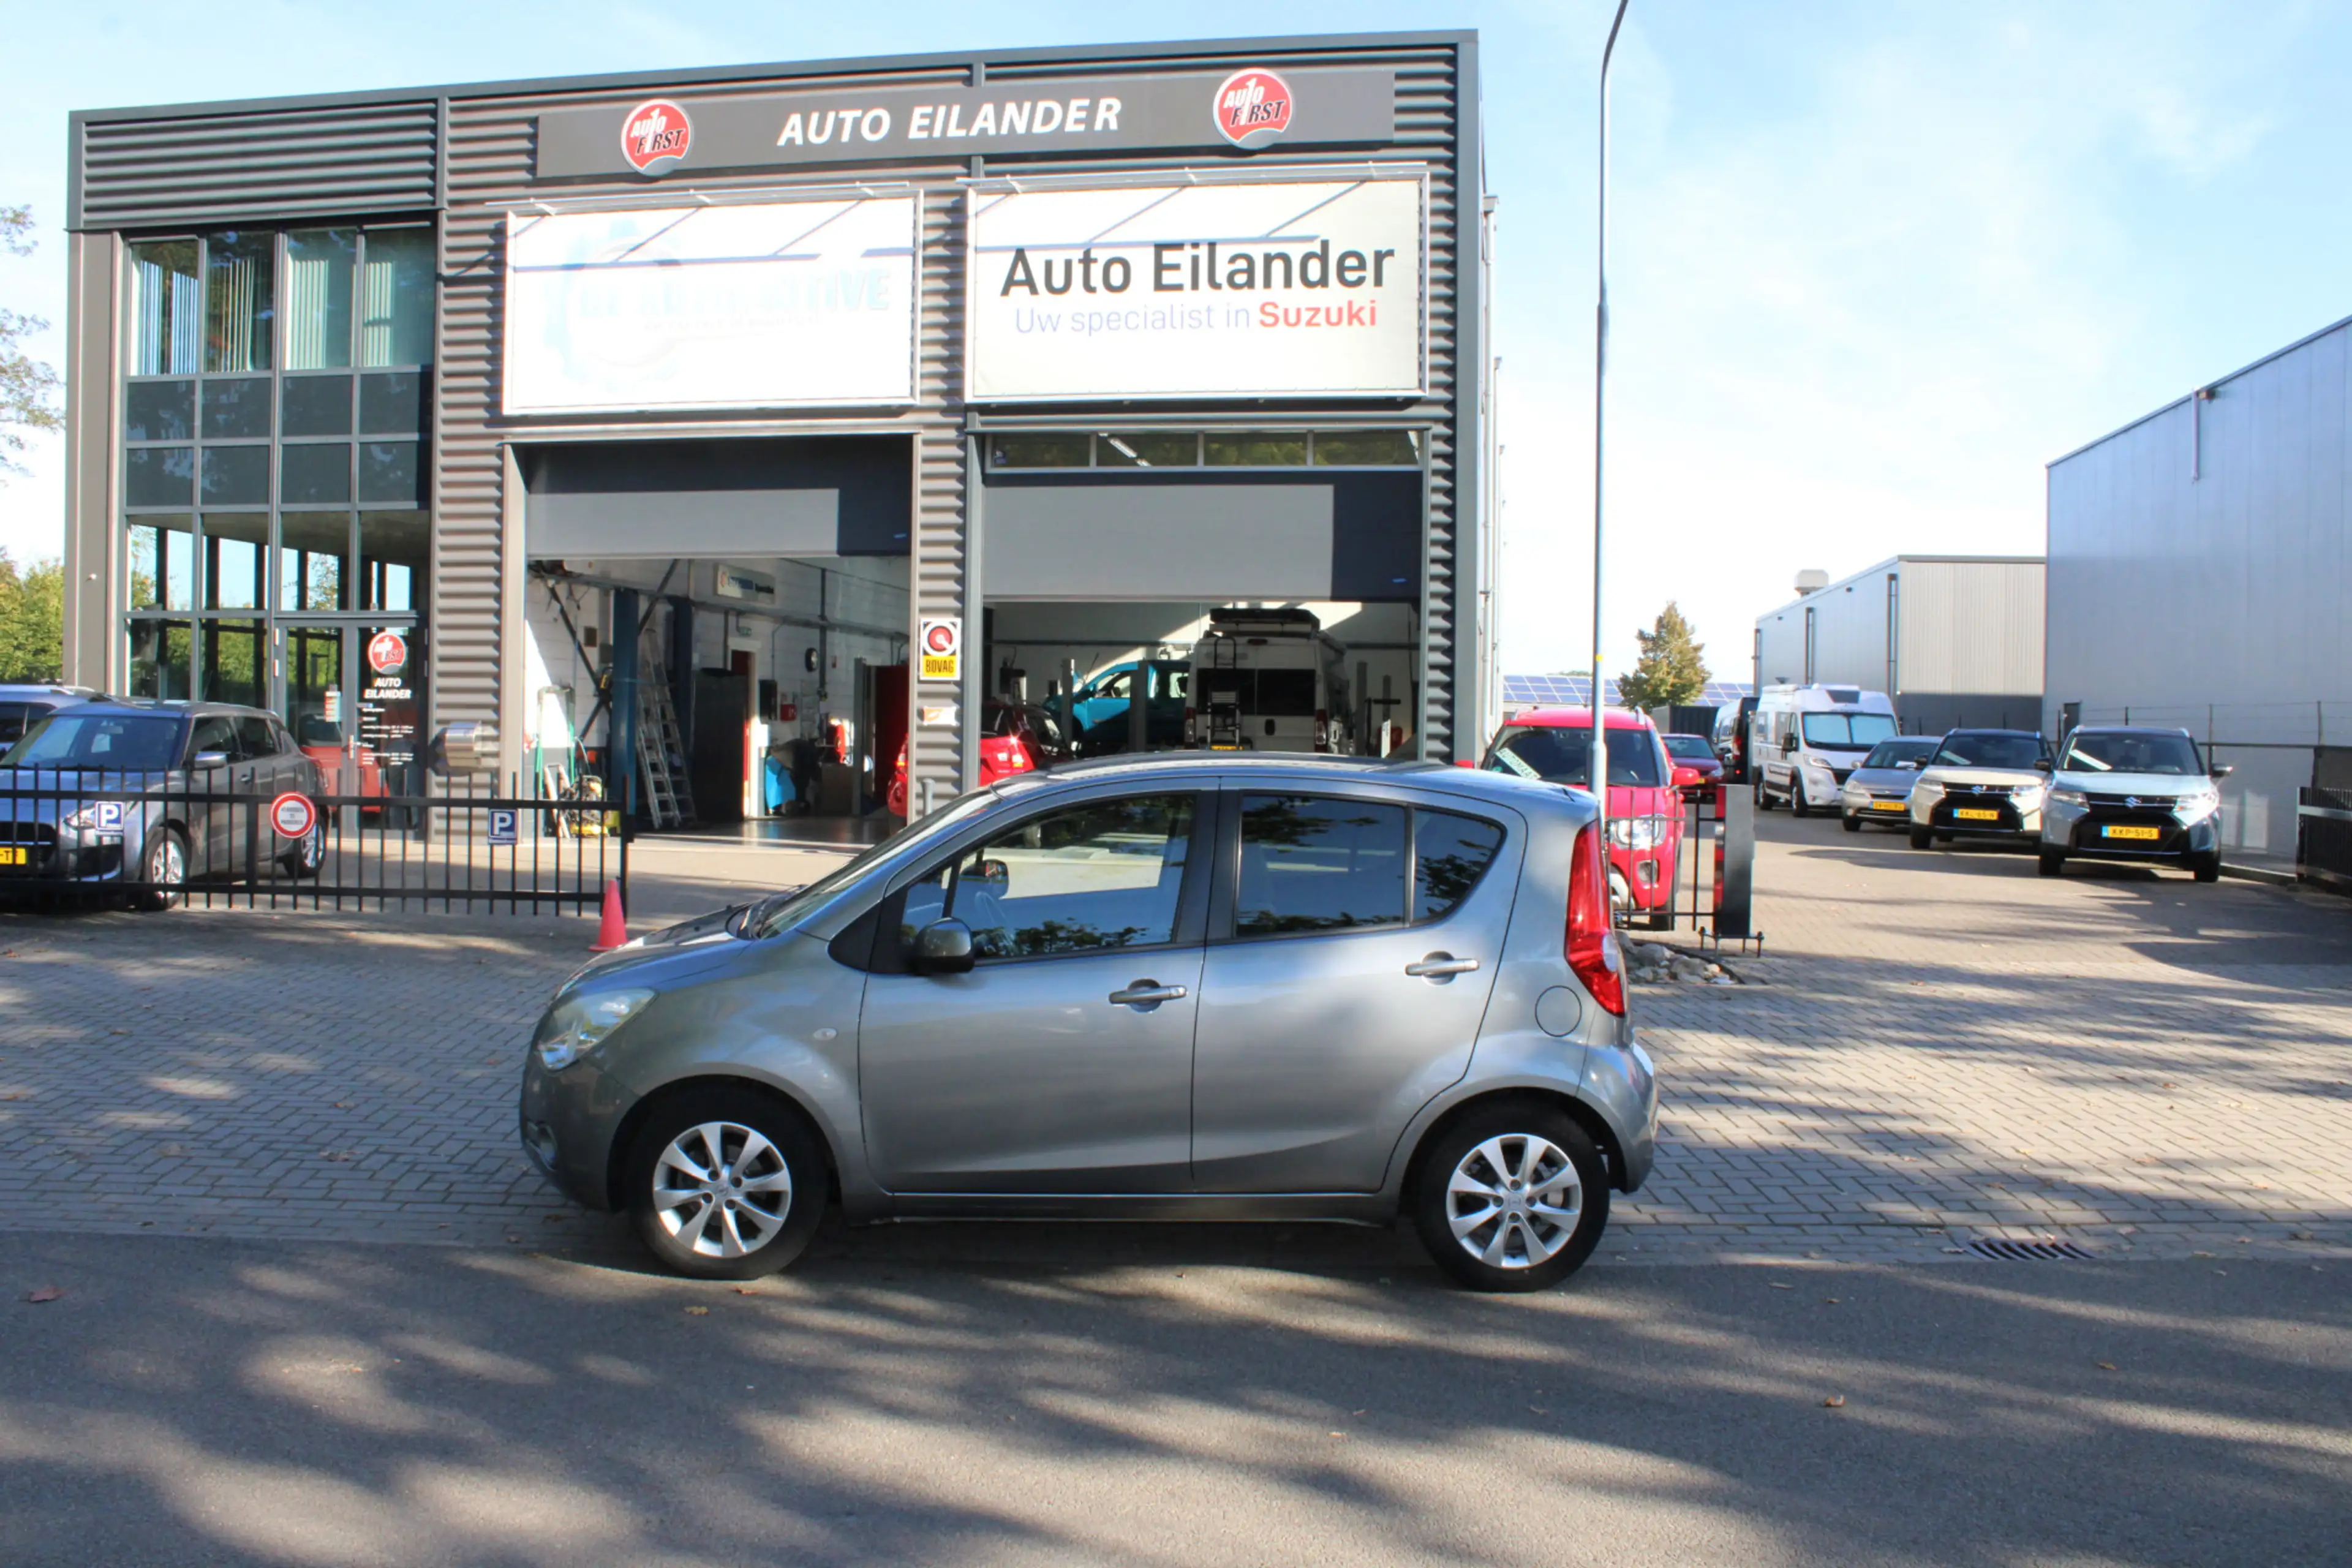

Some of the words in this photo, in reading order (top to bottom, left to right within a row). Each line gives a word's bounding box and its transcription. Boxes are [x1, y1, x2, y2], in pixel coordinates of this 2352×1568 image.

[777, 107, 891, 146] AUTO
[908, 97, 1122, 140] EILANDER
[1230, 99, 1286, 127] FIRST
[635, 127, 686, 156] FIRST
[1000, 247, 1132, 297] Auto
[1153, 239, 1395, 293] Eilander
[1016, 307, 1061, 334] Uw
[1071, 303, 1215, 337] specialist
[1226, 302, 1250, 329] in
[1259, 299, 1377, 329] Suzuki
[925, 659, 954, 674] BOVAG
[363, 688, 412, 699] EILANDER
[374, 677, 402, 687] AUTO
[100, 804, 119, 827] P
[493, 812, 513, 835] P
